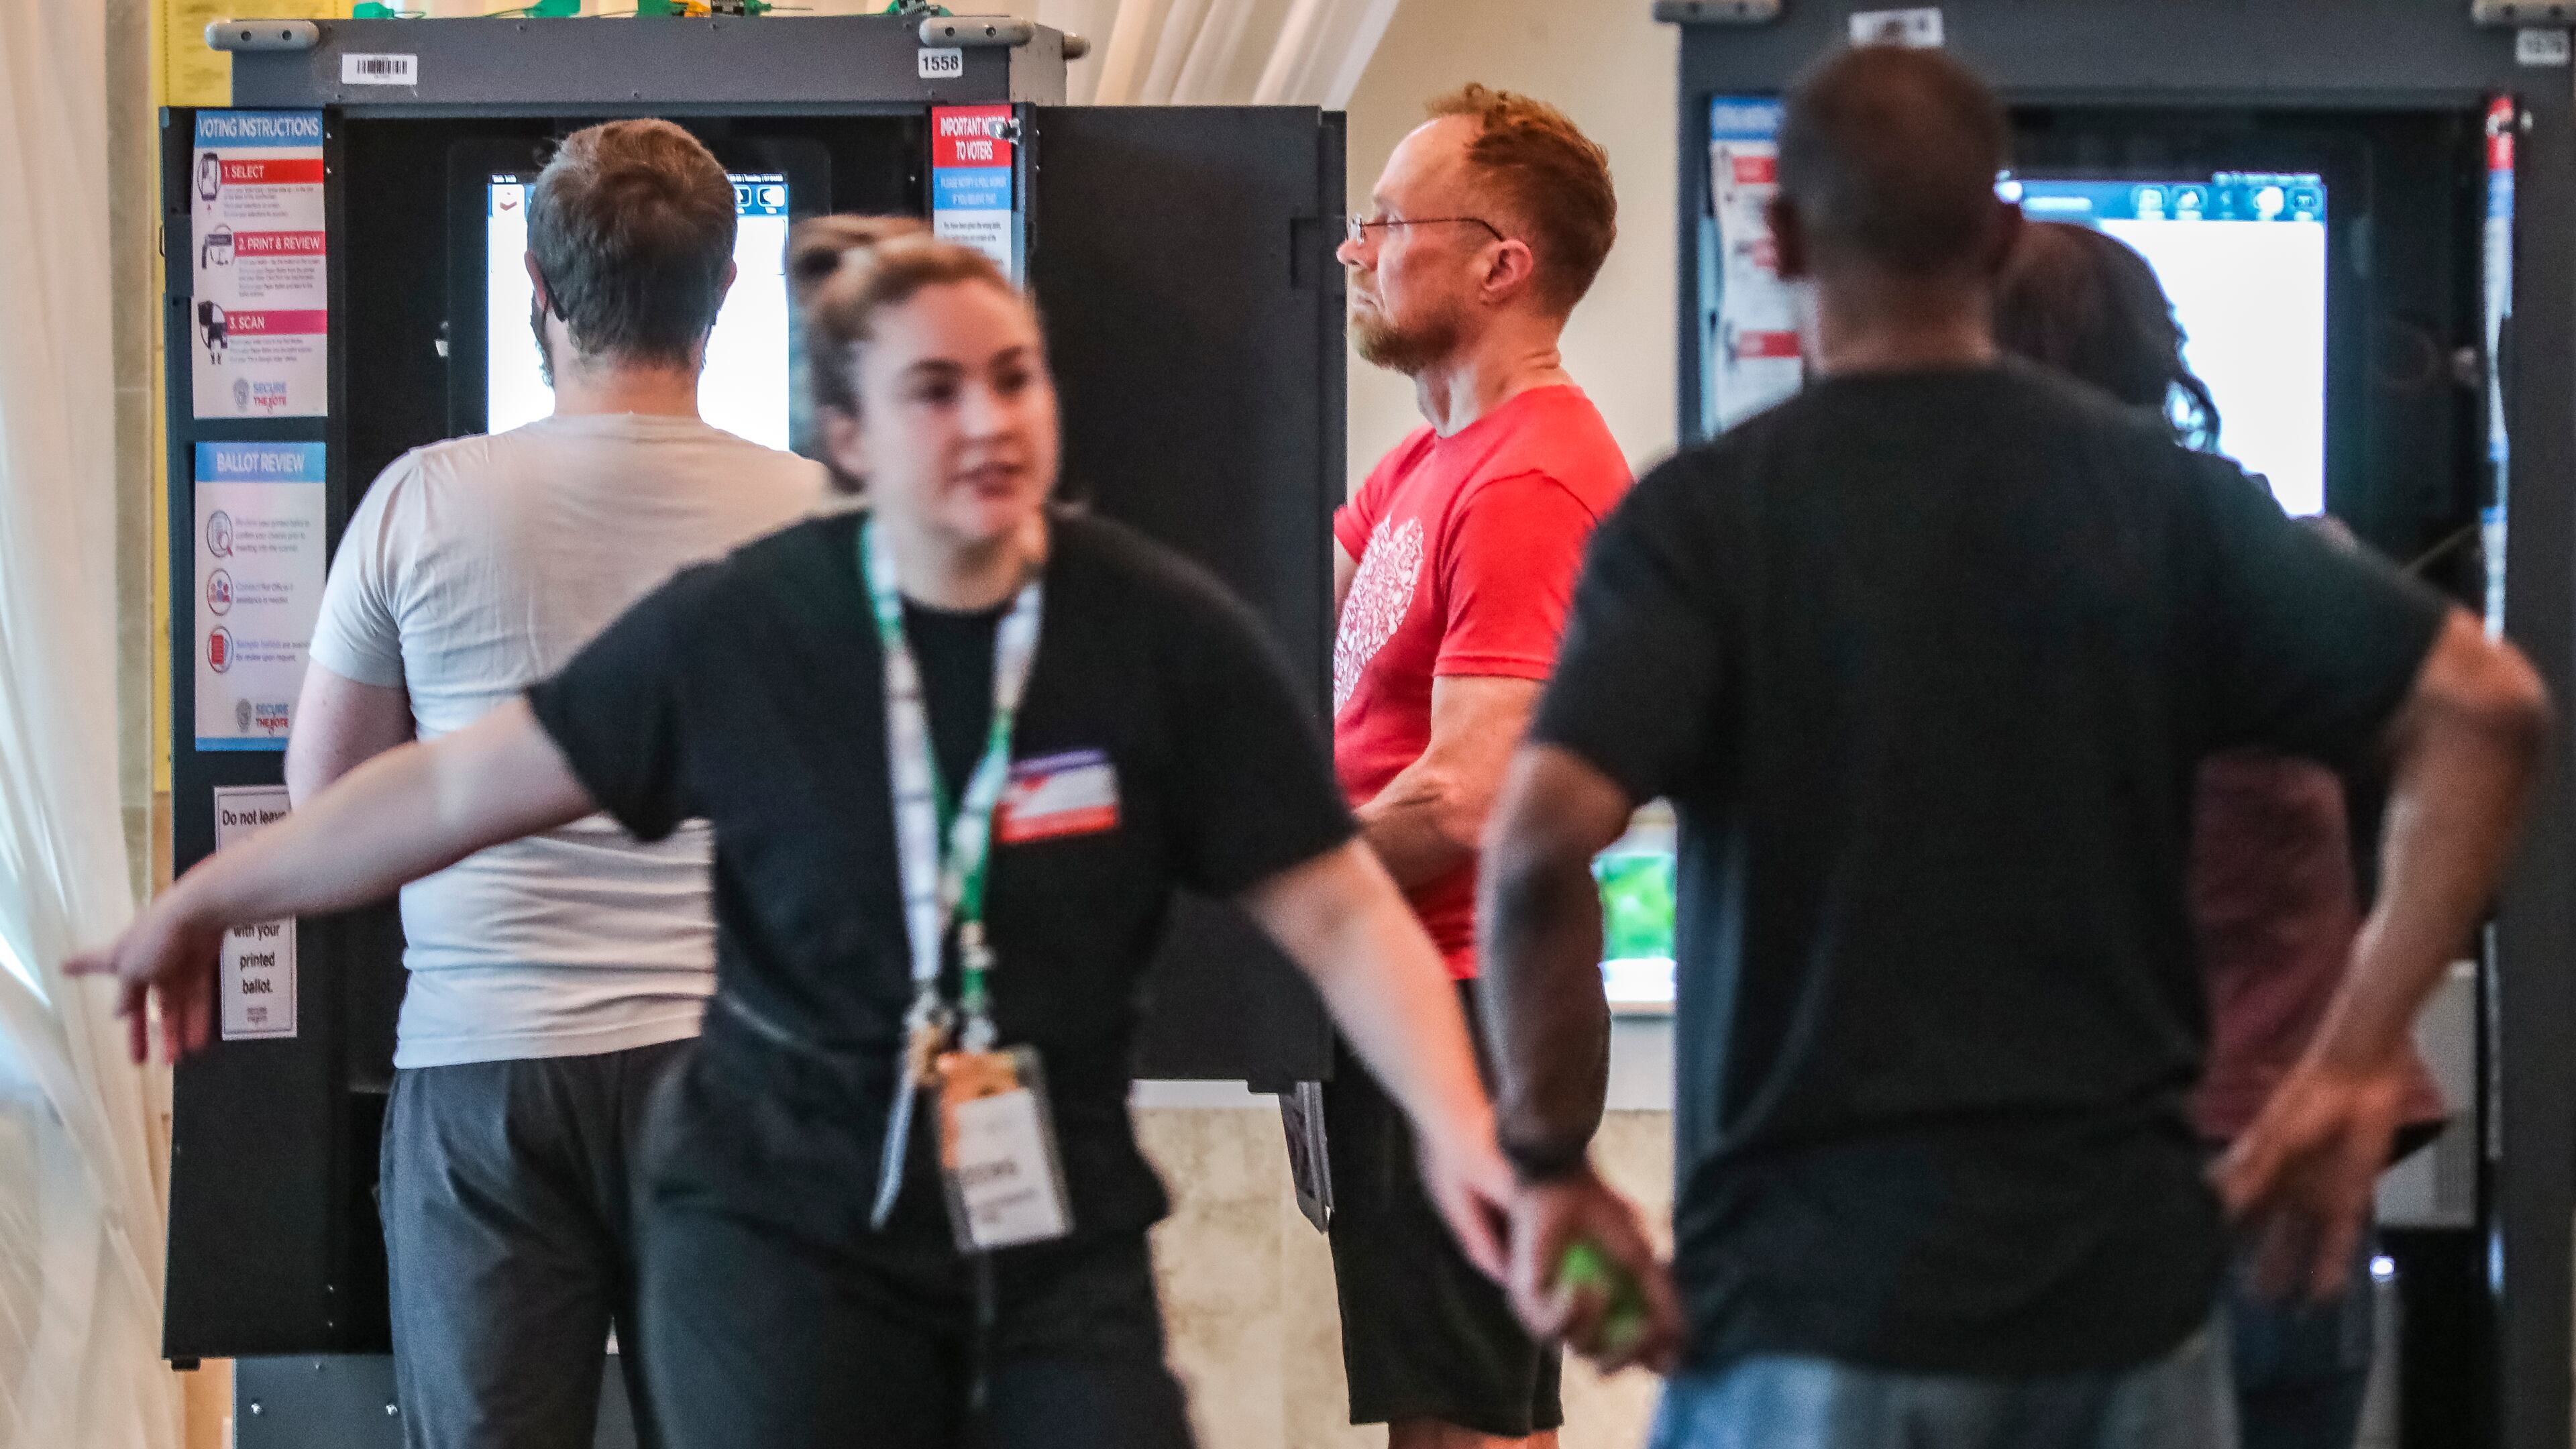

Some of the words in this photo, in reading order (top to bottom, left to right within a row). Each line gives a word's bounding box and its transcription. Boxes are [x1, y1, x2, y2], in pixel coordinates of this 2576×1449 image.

[922, 55, 959, 71] 1558
[199, 117, 237, 138] VOTING
[239, 117, 319, 137] INSTRUCTIONS
[941, 116, 981, 137] IMPORTANT
[955, 140, 966, 161] TO
[967, 139, 994, 161] VOTERS
[231, 165, 264, 179] SELECT
[247, 237, 272, 251] PRINT
[275, 237, 282, 250] &
[283, 236, 320, 250] REVIEW
[238, 316, 265, 329] SCAN
[217, 451, 259, 472] BALLOT
[260, 452, 305, 473] REVIEW
[222, 809, 237, 826] Do
[239, 809, 257, 826] not
[233, 924, 255, 938] with
[257, 924, 280, 941] your
[240, 951, 275, 972] printed
[242, 978, 273, 995] ballot.
